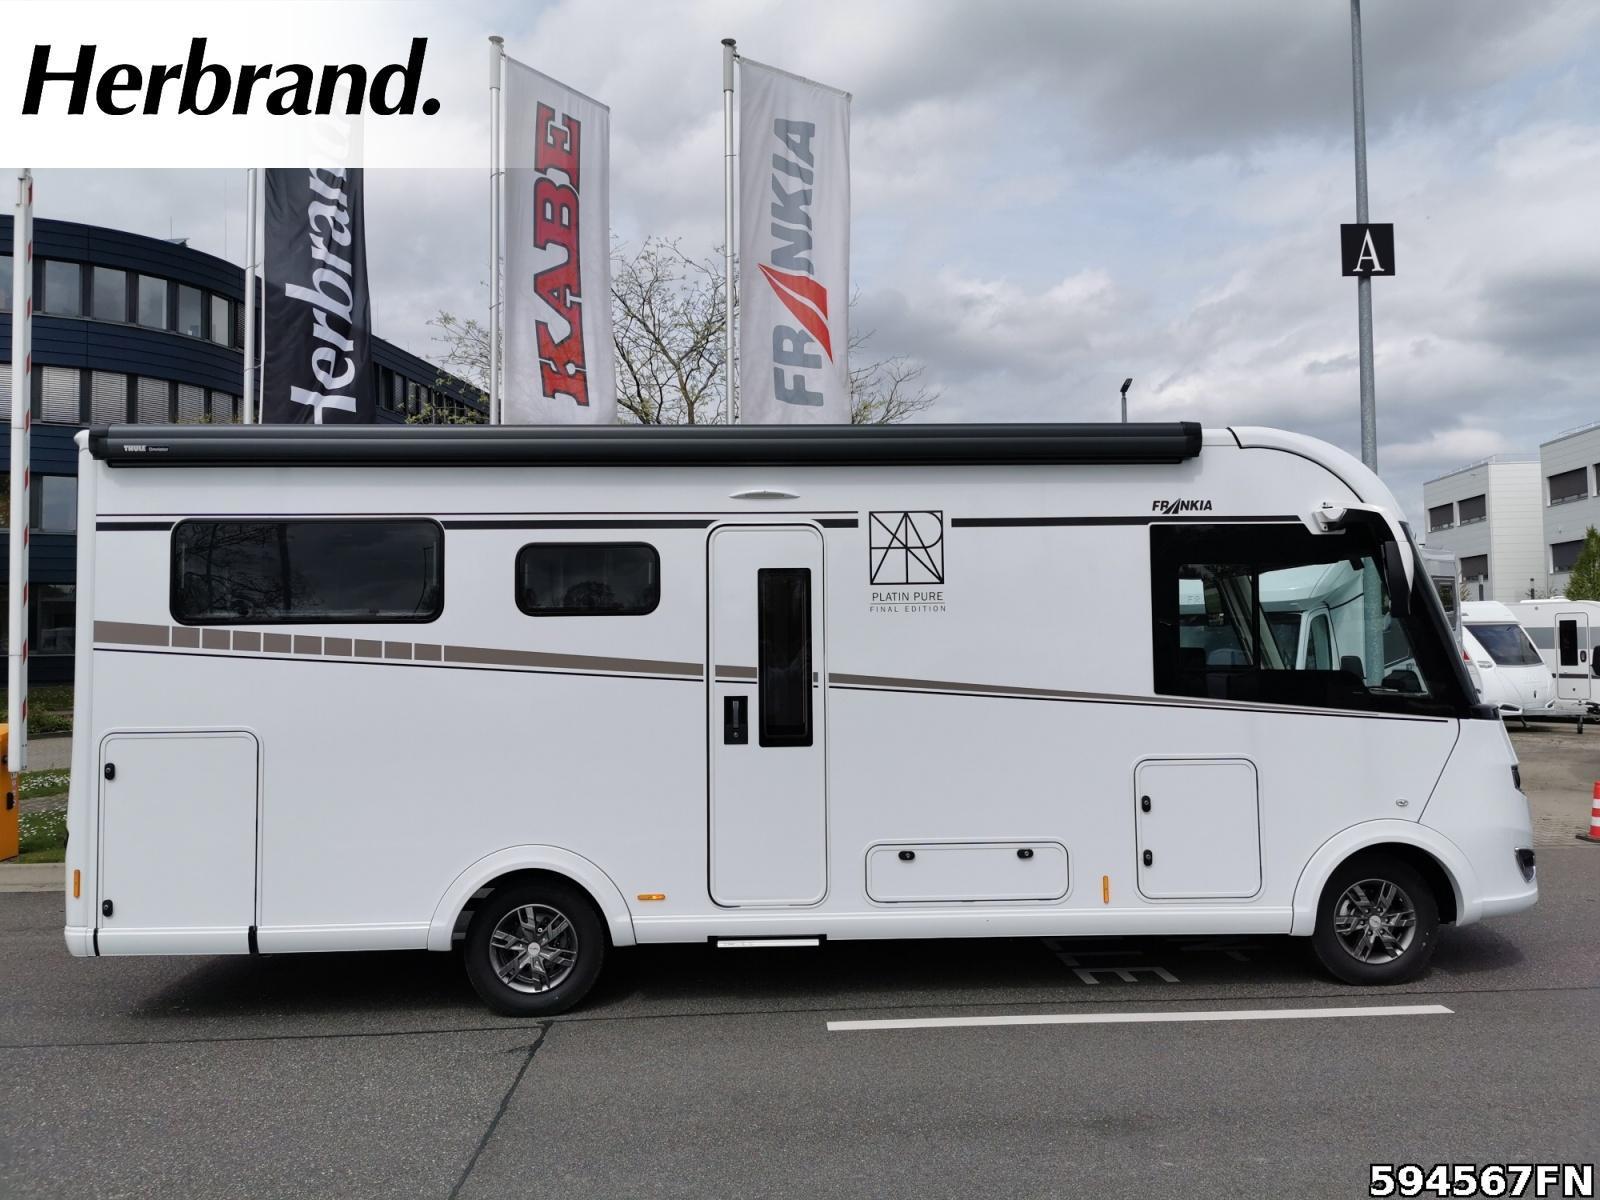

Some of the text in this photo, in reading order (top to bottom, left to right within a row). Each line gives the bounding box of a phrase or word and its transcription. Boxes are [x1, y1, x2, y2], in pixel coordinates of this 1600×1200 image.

[534, 101, 589, 407] KABE
[758, 118, 833, 407] FRANKIA
[1352, 228, 1385, 272] A
[1152, 498, 1213, 514] FRANKIA
[872, 592, 943, 601] PLATIN PURE
[905, 605, 946, 613] EDITION
